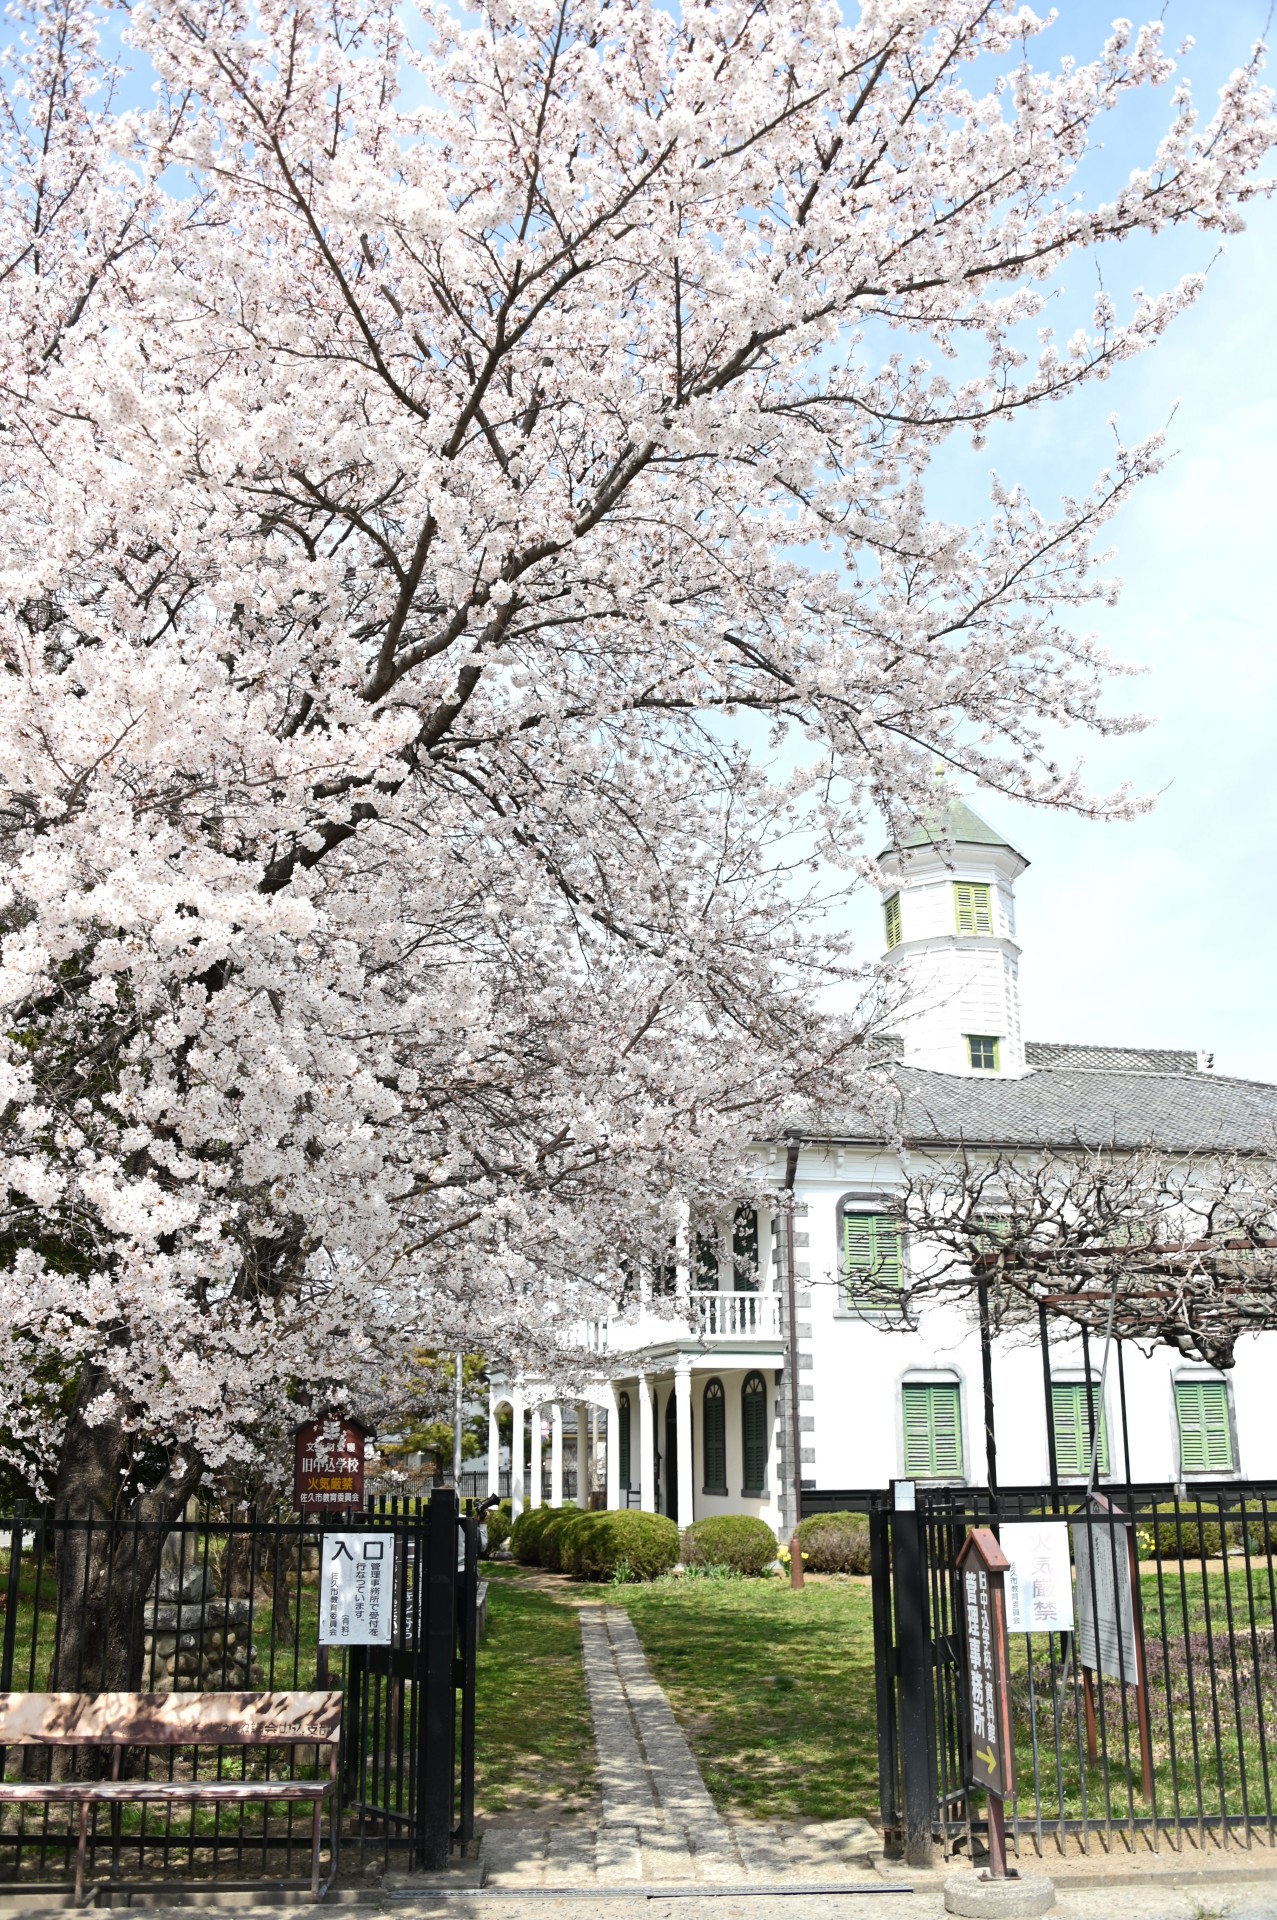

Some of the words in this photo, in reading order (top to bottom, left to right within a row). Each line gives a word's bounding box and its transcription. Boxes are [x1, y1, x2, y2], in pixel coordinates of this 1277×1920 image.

[302, 1457, 359, 1473] 旧中込学校
[307, 1477, 353, 1491] 火気厳禁
[300, 1492, 360, 1503] 佐久市教育委員会
[331, 1541, 384, 1560] 入口
[1030, 1534, 1058, 1622] 火気厳禁
[369, 1562, 381, 1636] 管理事務所で受付を
[965, 1571, 985, 1738] 管理事務所
